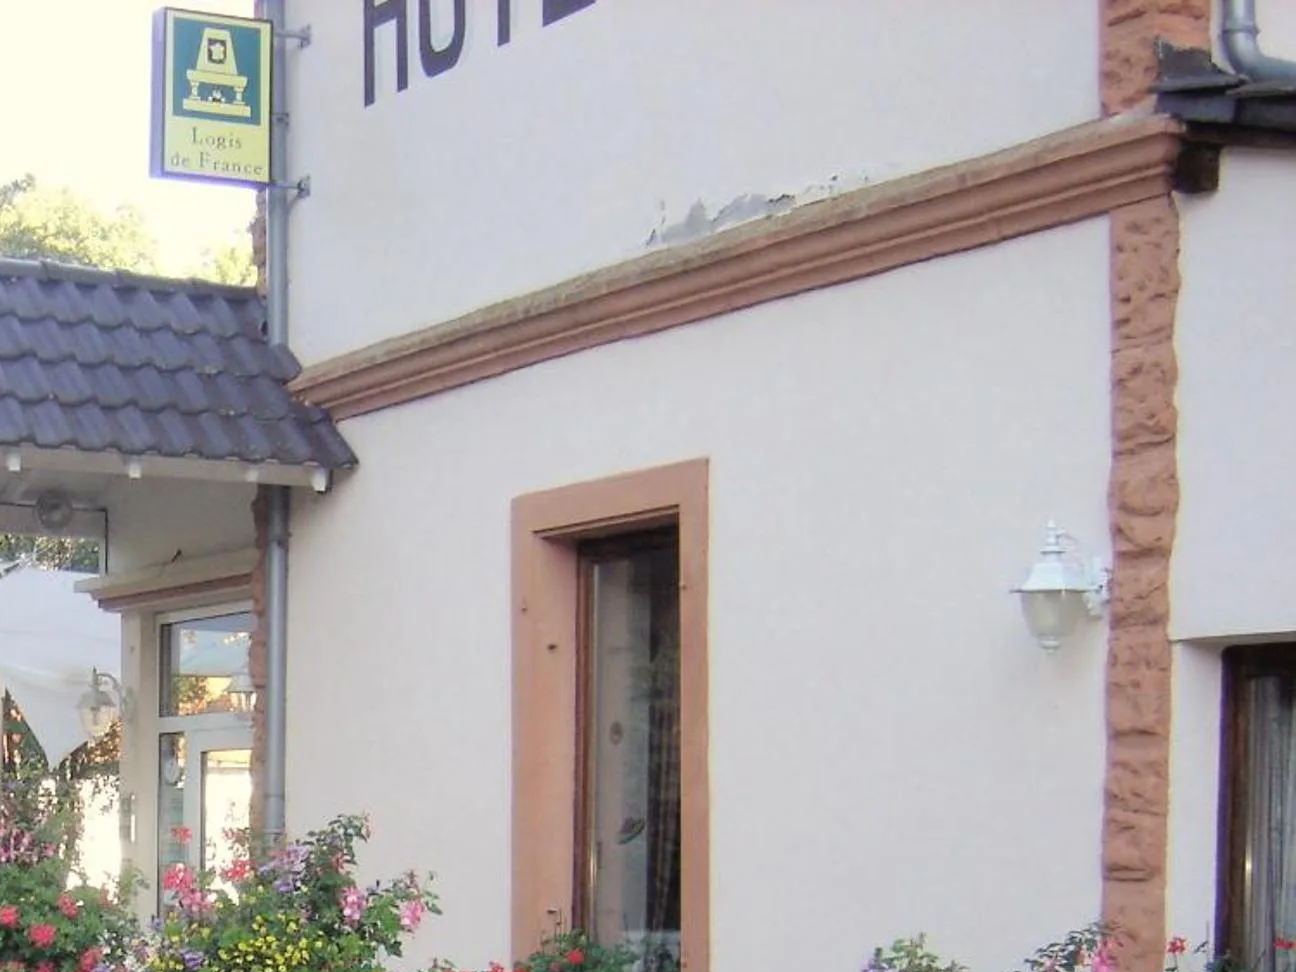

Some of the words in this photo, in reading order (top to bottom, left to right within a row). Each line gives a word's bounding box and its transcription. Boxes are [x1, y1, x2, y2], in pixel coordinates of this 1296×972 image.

[191, 126, 242, 151] Logis
[170, 151, 191, 168] de
[198, 151, 264, 176] France
